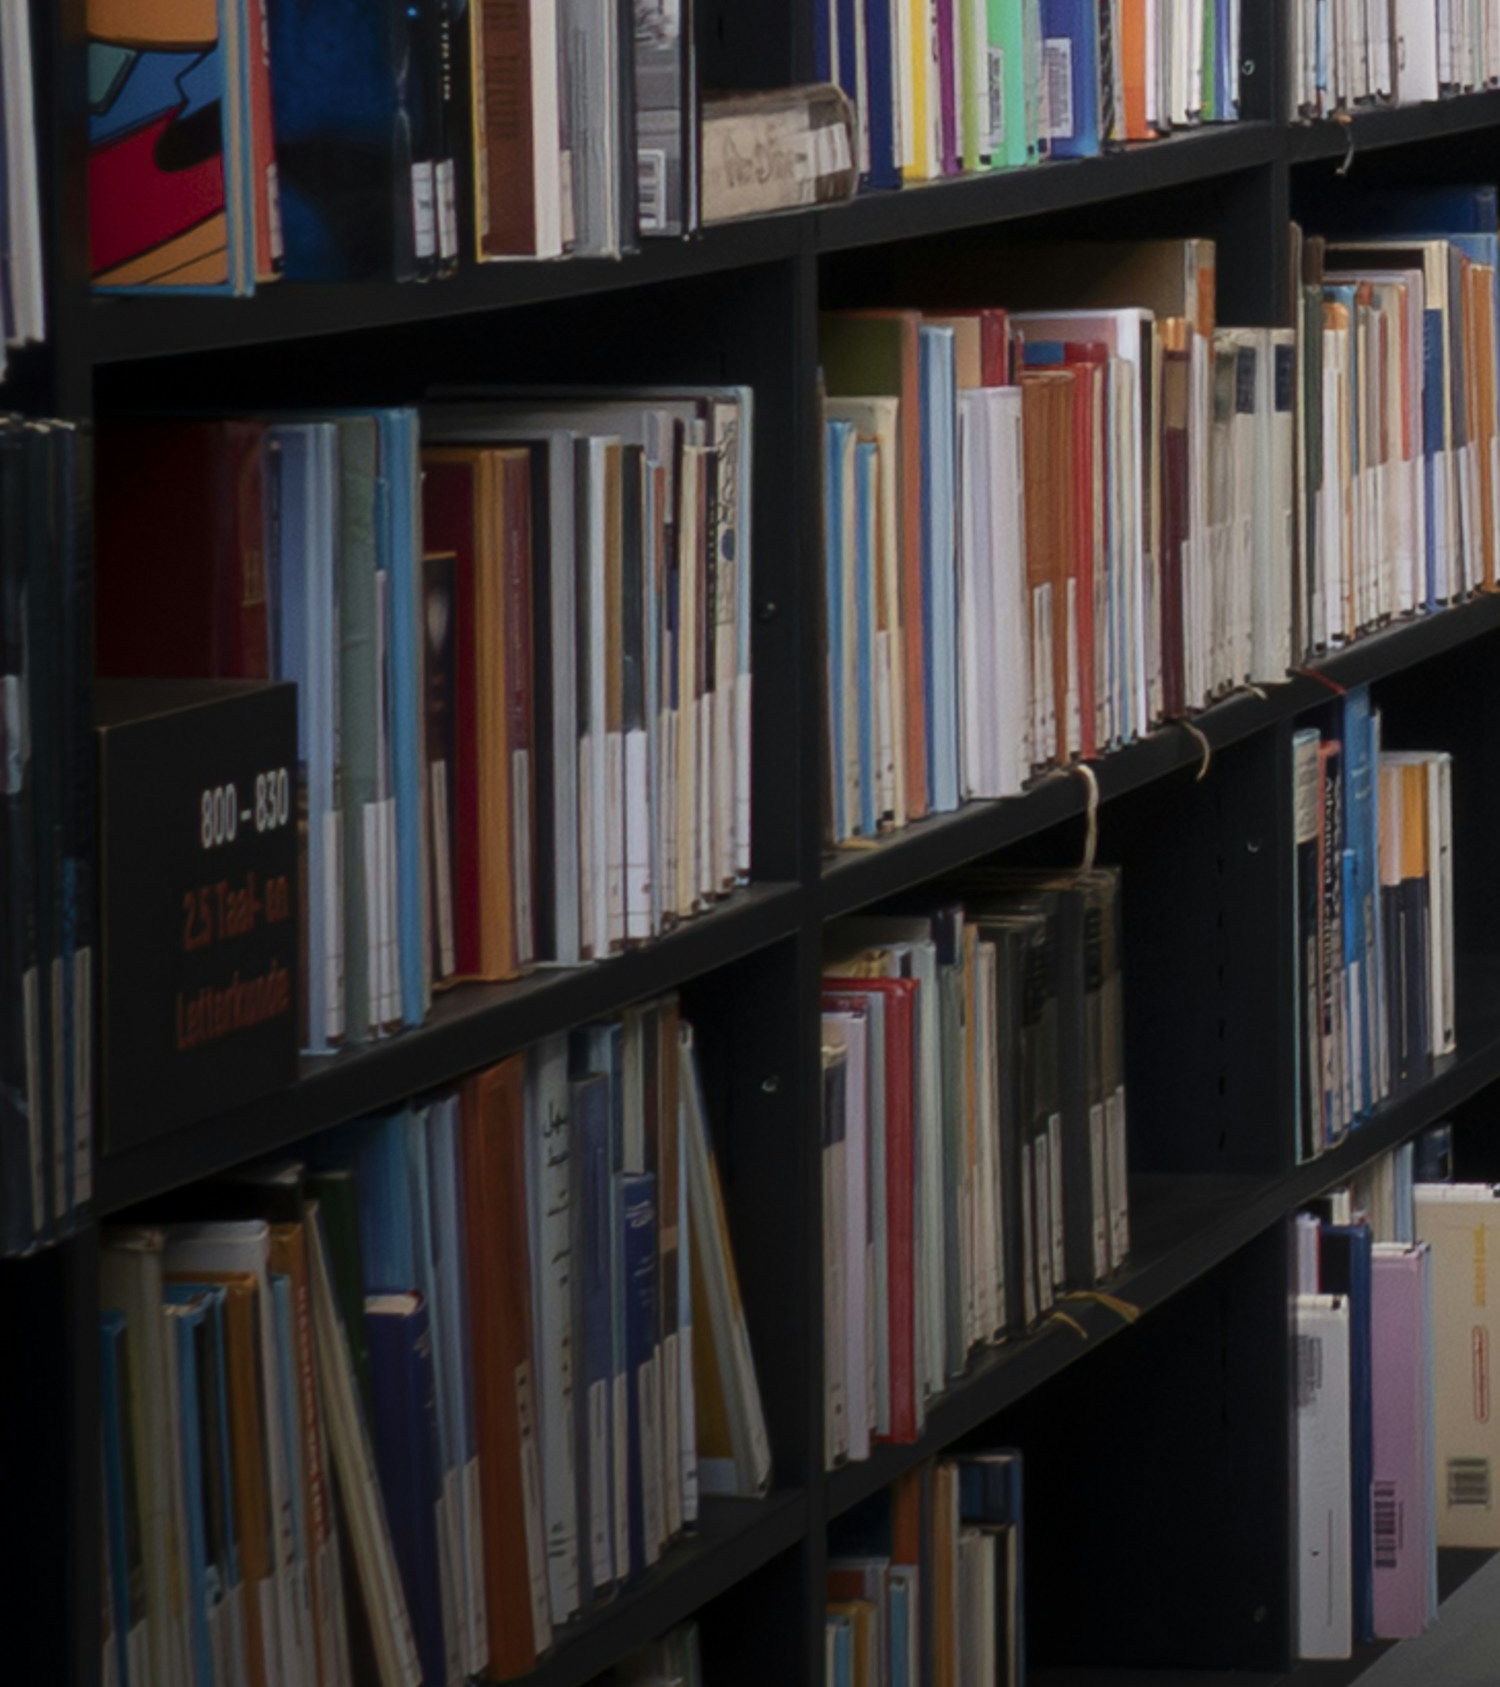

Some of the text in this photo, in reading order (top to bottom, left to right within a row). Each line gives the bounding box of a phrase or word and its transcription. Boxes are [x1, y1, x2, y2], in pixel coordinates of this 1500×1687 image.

[199, 781, 238, 850] 800
[255, 765, 290, 834] 830
[176, 955, 291, 1052] Letterkunde
